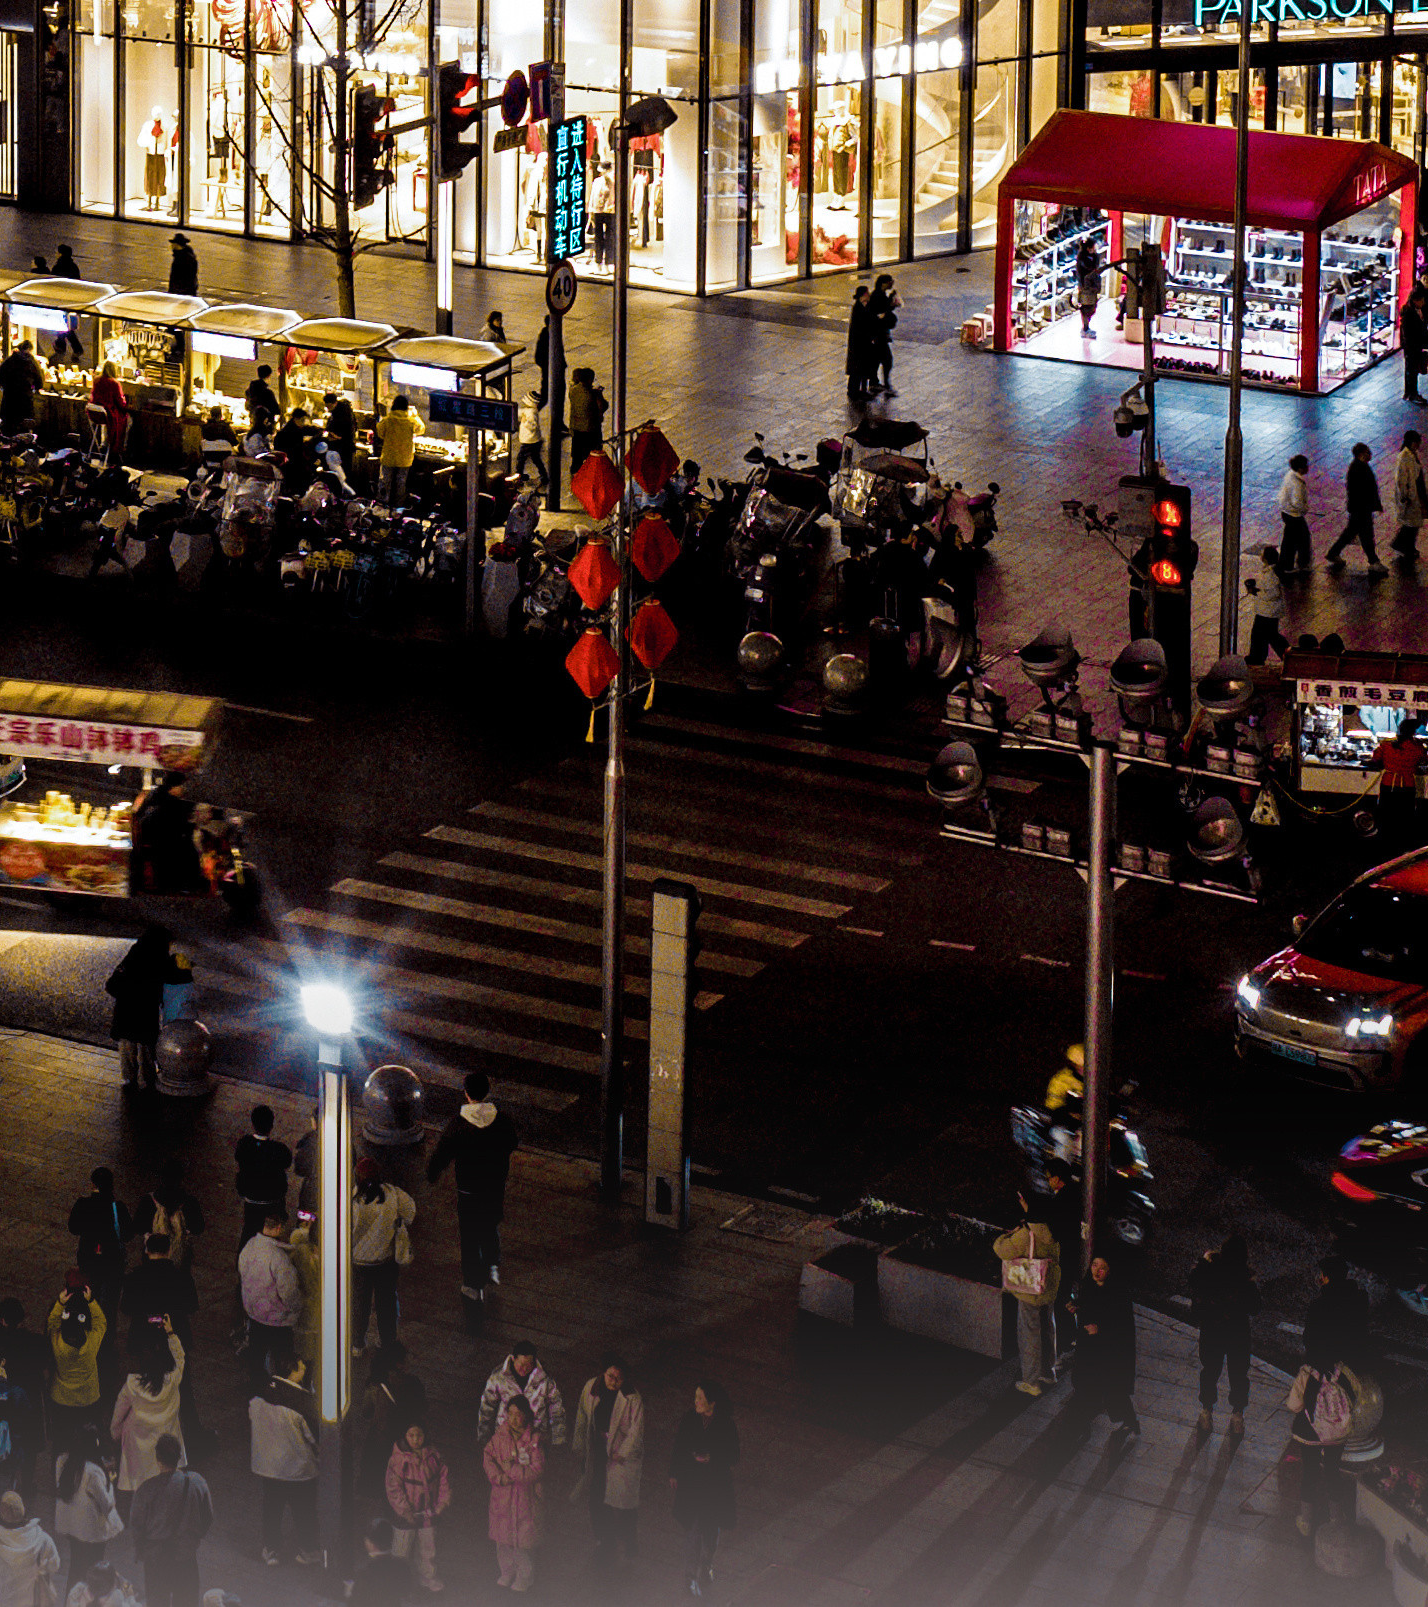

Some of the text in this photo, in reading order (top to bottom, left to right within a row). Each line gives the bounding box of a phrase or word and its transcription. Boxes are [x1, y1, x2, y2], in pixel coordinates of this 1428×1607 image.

[553, 124, 569, 260] 直行机动车
[569, 119, 584, 254] 进入待行区
[552, 275, 572, 300] 40
